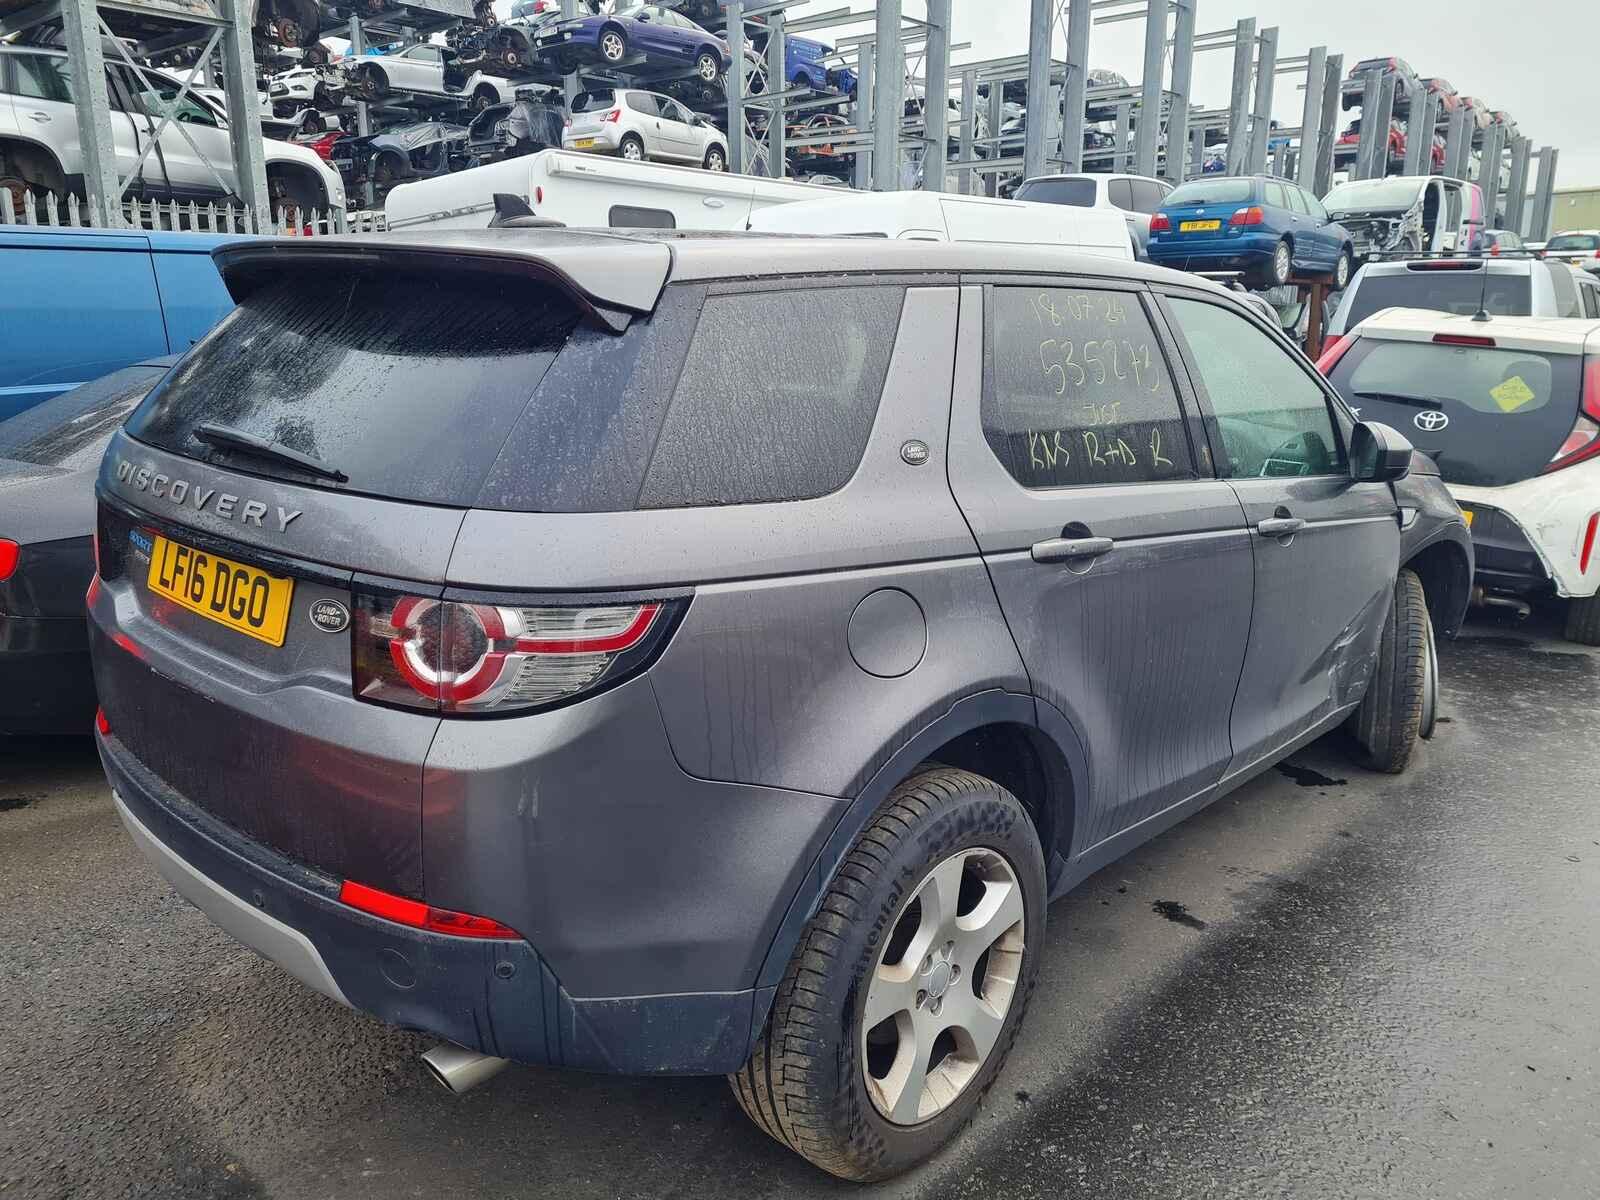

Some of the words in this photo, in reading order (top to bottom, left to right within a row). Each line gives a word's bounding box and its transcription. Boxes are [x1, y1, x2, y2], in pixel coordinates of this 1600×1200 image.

[117, 460, 303, 533] DISCOVERY
[159, 540, 208, 603] LF16
[210, 561, 270, 628] DGO
[317, 605, 337, 616] LAND
[317, 613, 340, 625] ROVER
